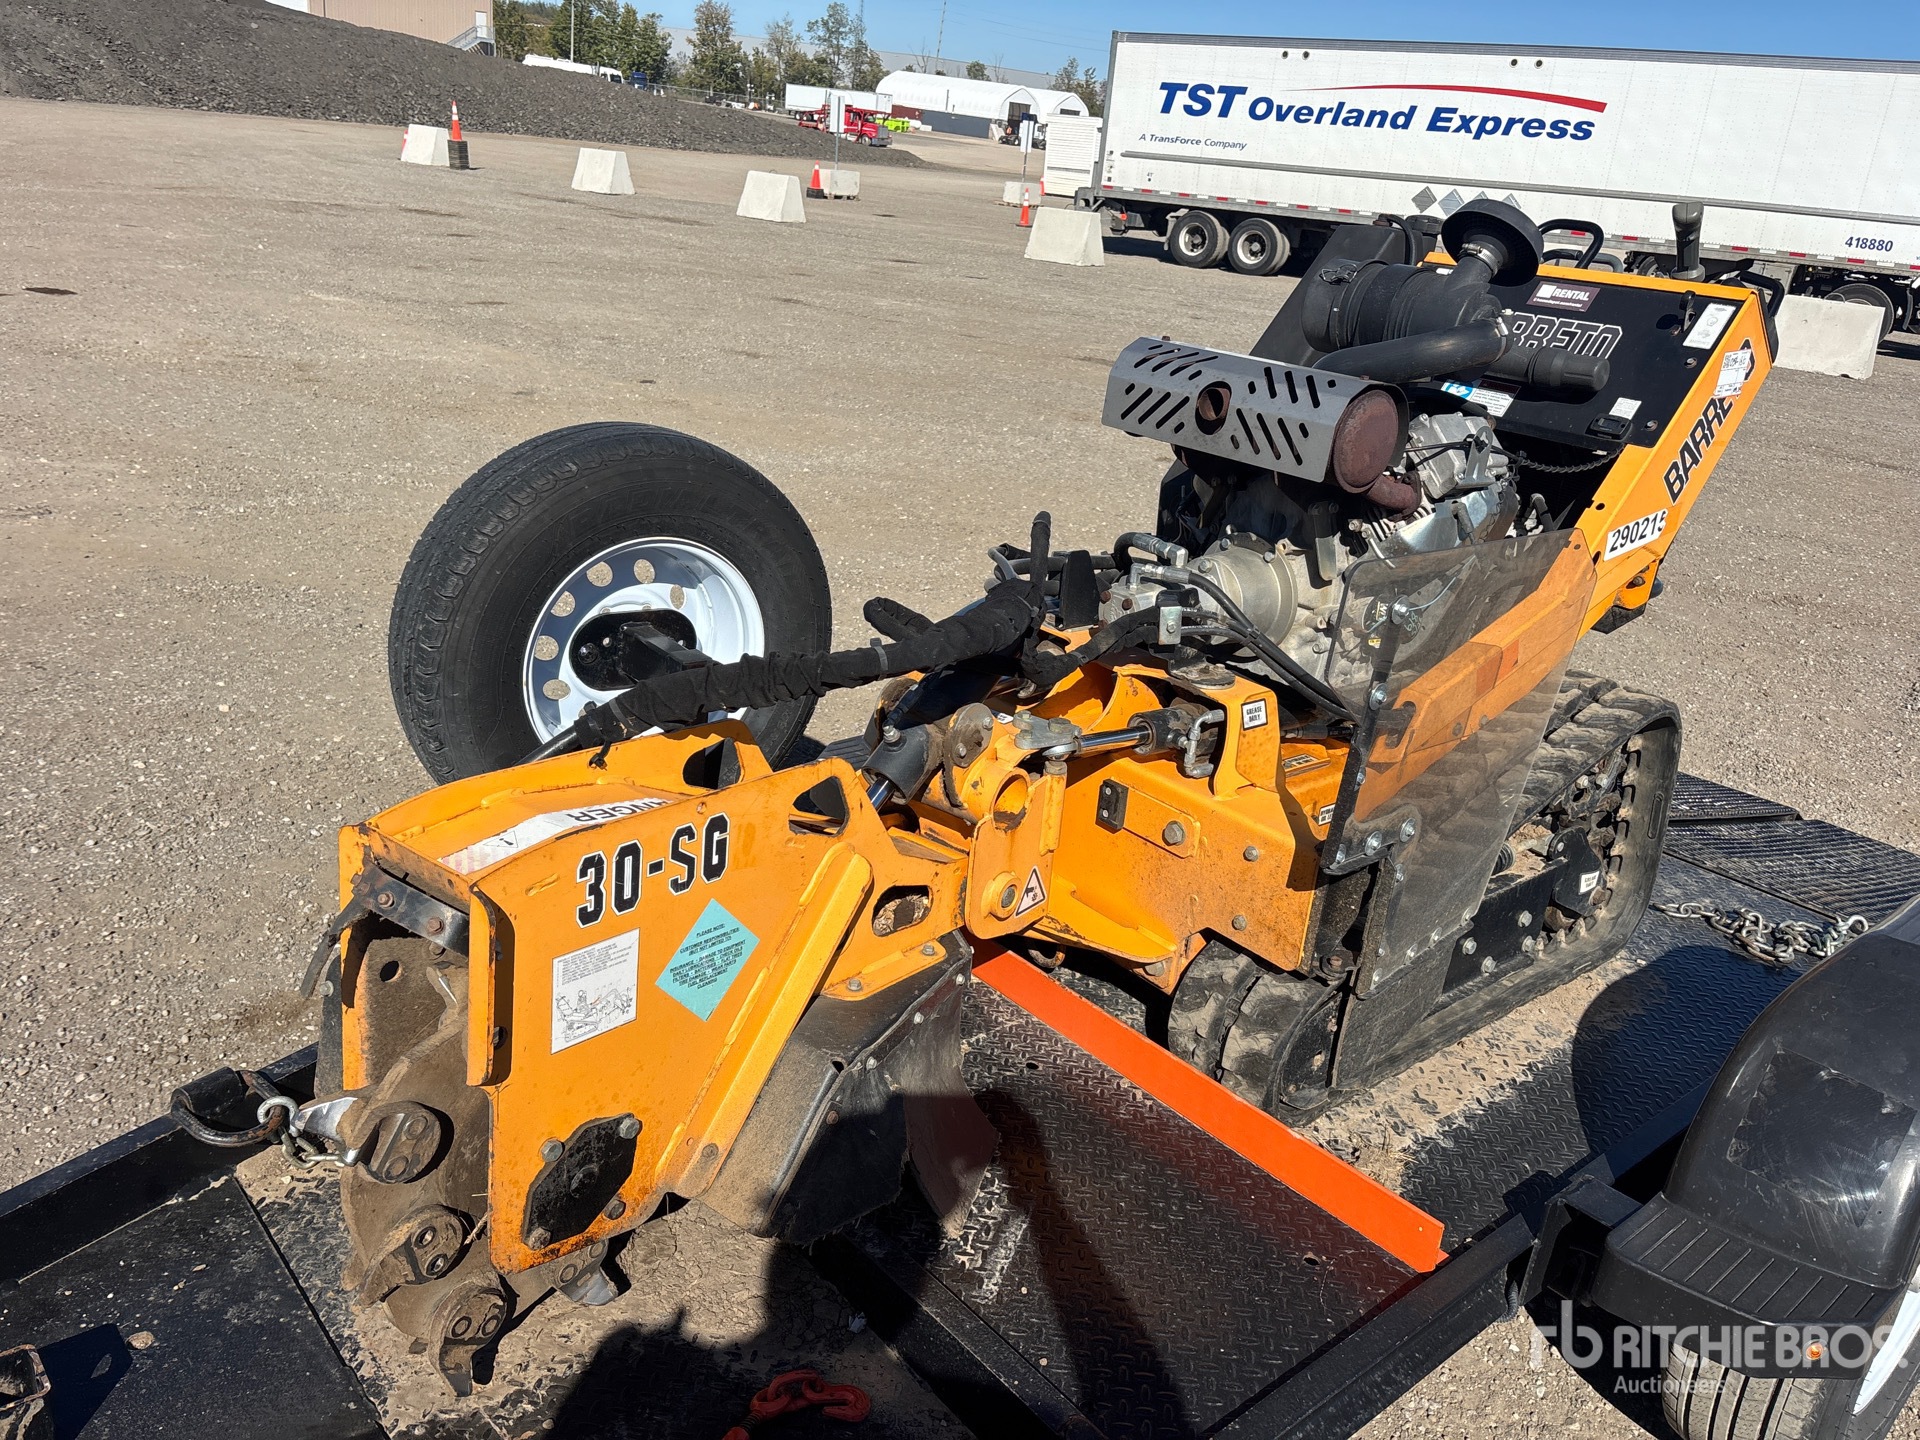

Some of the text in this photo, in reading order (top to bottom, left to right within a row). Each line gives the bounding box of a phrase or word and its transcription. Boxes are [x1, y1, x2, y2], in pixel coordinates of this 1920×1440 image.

[1159, 81, 1596, 141] TST Overland Express
[1139, 133, 1248, 151] A TransForce Company
[1845, 236, 1894, 252] 418880
[1552, 288, 1590, 301] RENTAL
[1246, 705, 1262, 716] GREASE
[1248, 714, 1260, 723] DAILY
[576, 812, 731, 928] 30-SG
